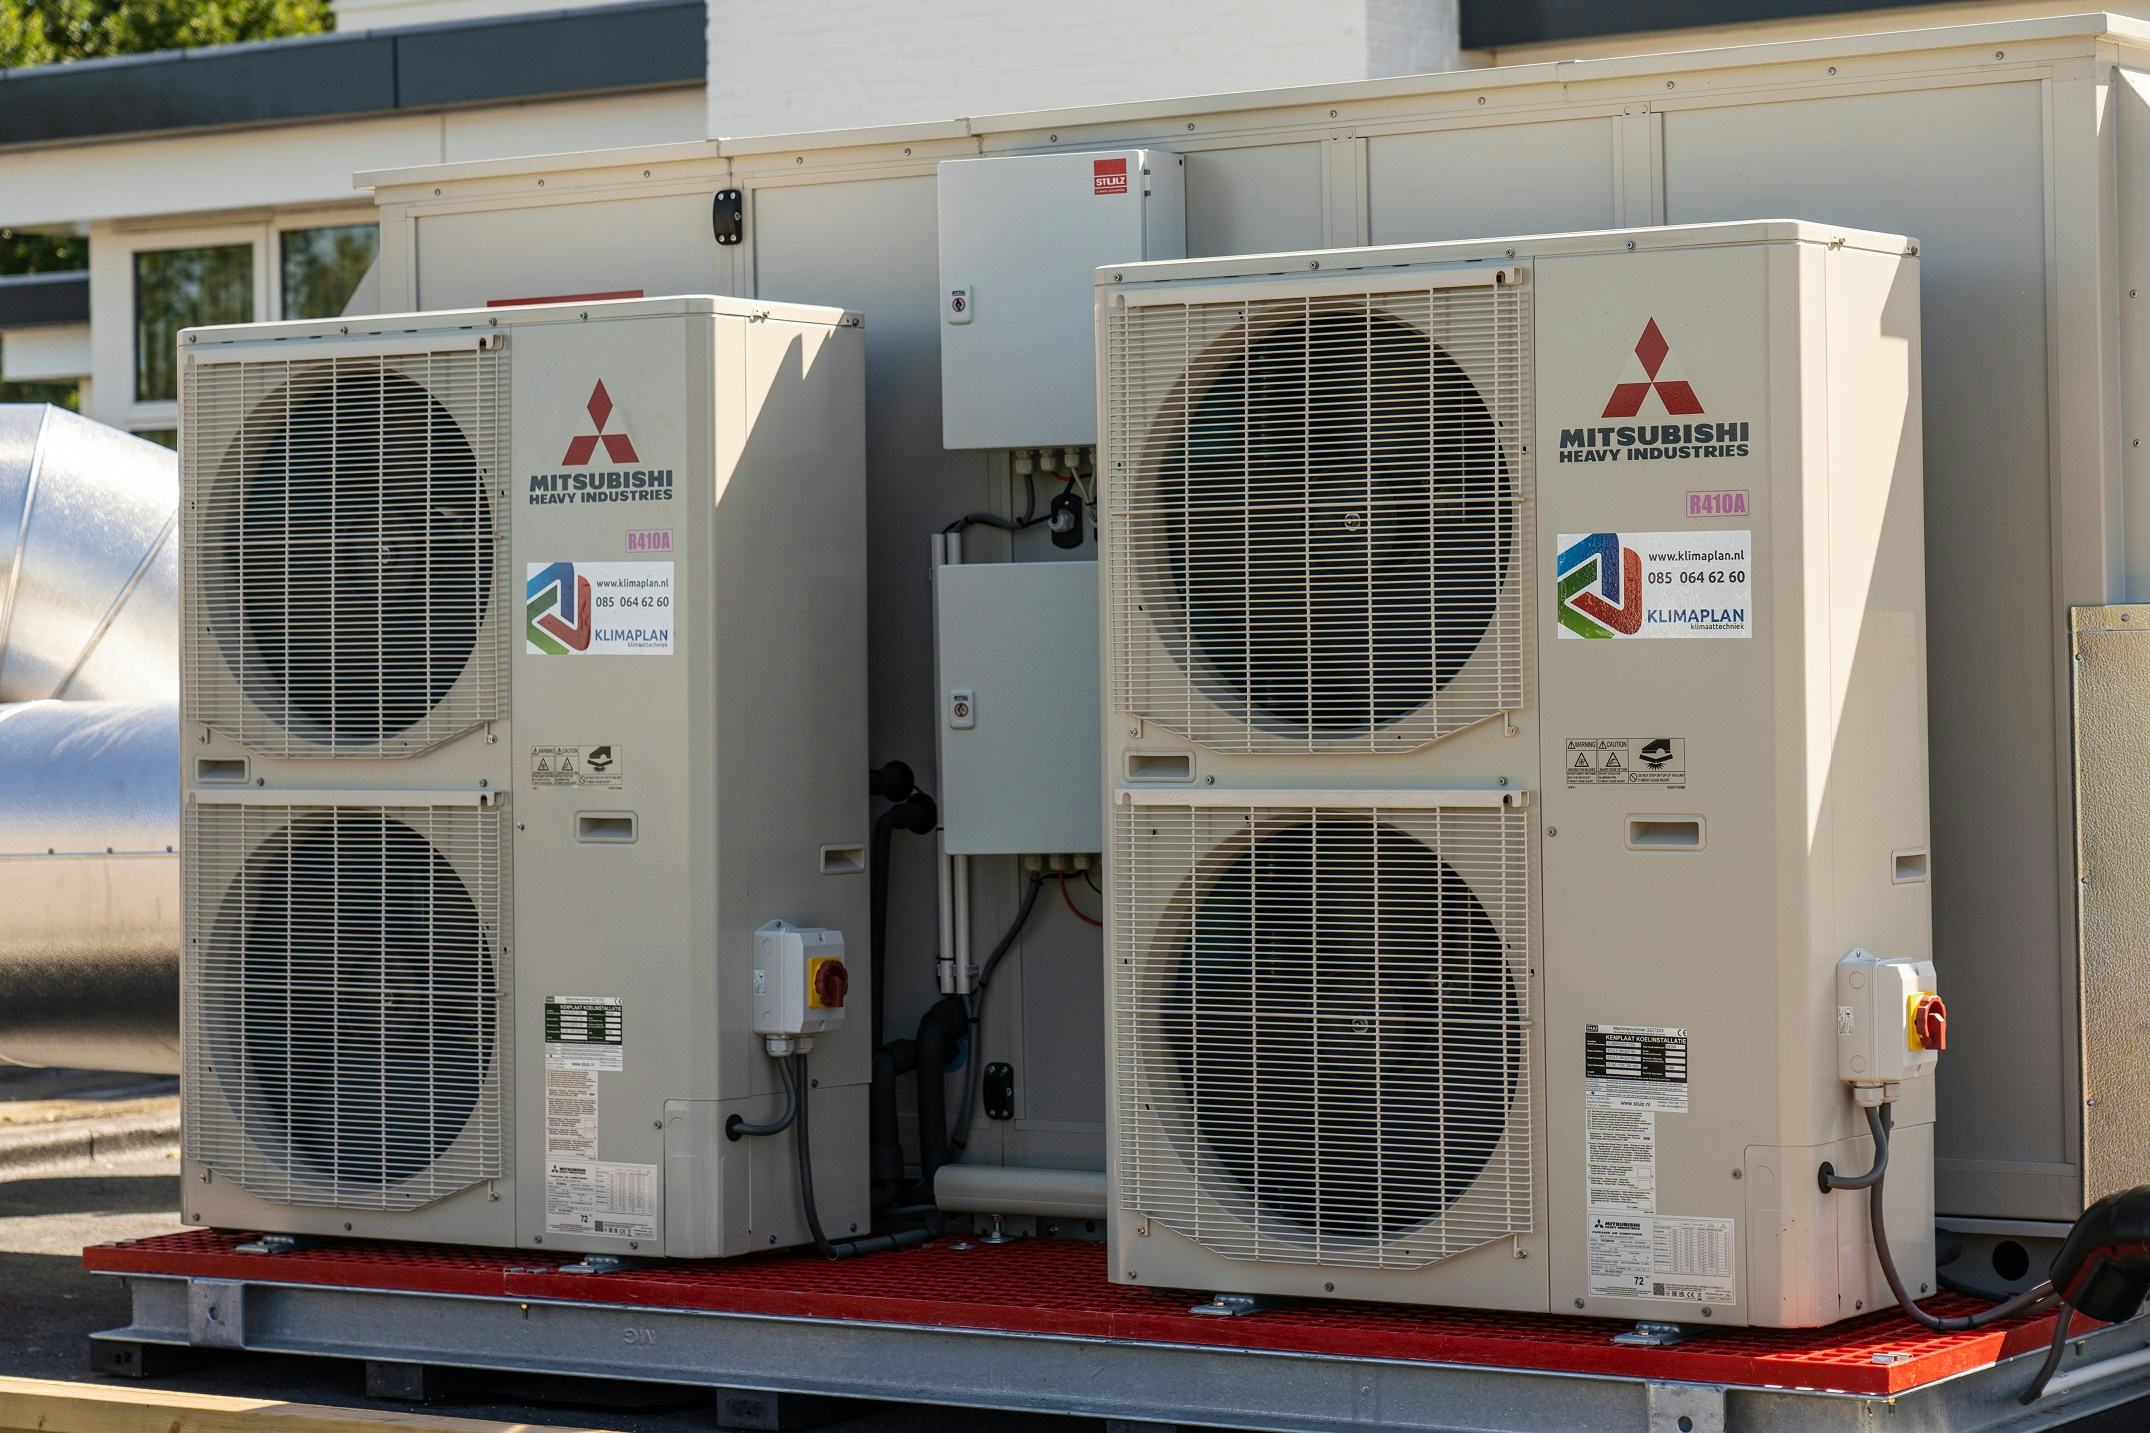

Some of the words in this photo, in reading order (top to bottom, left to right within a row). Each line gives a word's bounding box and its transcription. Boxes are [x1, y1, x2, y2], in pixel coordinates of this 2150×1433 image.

[1096, 177, 1125, 186] STULZ
[1559, 422, 1749, 448] MITSUBISHI
[1559, 449, 1621, 463] HEAVY
[1627, 444, 1749, 461] INDUSTRIES
[529, 470, 673, 492] MITSUBISHI
[529, 493, 577, 505] HEAVY
[581, 489, 673, 503] INDUSTRIES
[1689, 493, 1745, 514] R410A
[628, 531, 671, 550] R410A
[1648, 550, 1745, 563] www.klimaplan.nl
[596, 578, 669, 589] www.klimaplan.nl
[1648, 571, 1672, 584] 085
[1680, 571, 1704, 584] 064
[1708, 570, 1724, 583] 62
[1729, 570, 1745, 583] 60
[596, 597, 614, 607] 085
[620, 597, 639, 607] 064
[641, 597, 653, 607] 62
[656, 596, 669, 607] 60
[1647, 609, 1744, 623] KLIMAPLAN
[595, 629, 668, 641] KLIMAPLAN
[1635, 1036, 1686, 1044] KOELINSTALLATIE
[1634, 1276, 1644, 1286] 72
